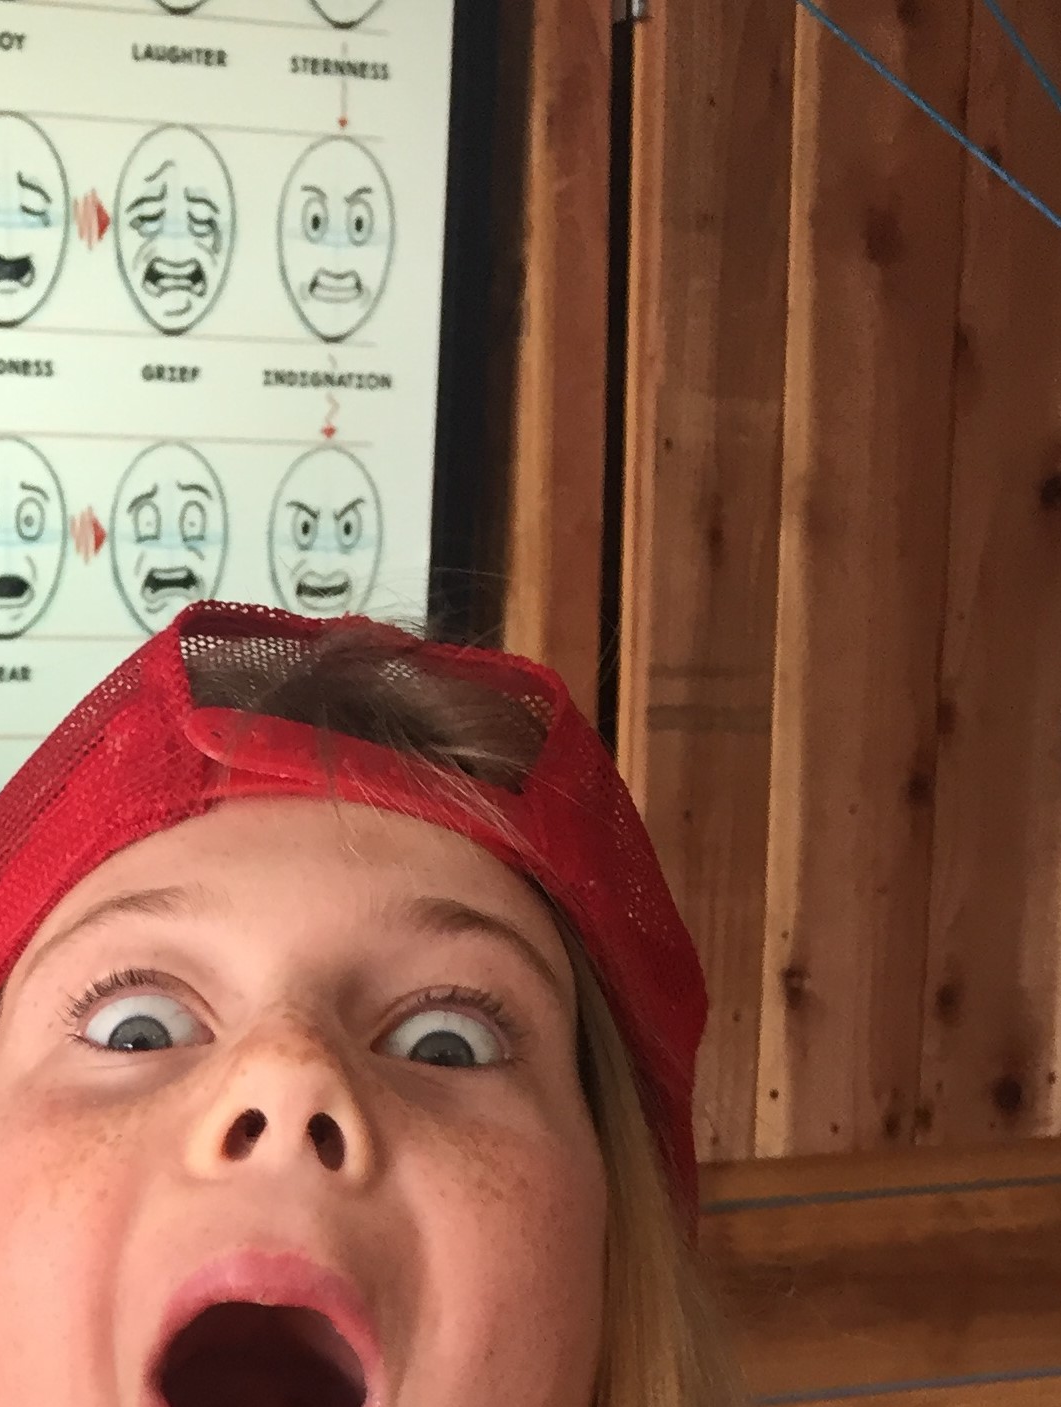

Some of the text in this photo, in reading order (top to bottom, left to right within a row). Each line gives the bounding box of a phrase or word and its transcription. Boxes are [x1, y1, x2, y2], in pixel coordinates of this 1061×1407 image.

[131, 43, 229, 68] LAUGHTER
[290, 55, 391, 81] STERNNESS
[141, 363, 201, 384] GRIEF
[263, 369, 393, 392] INDIGNATION
